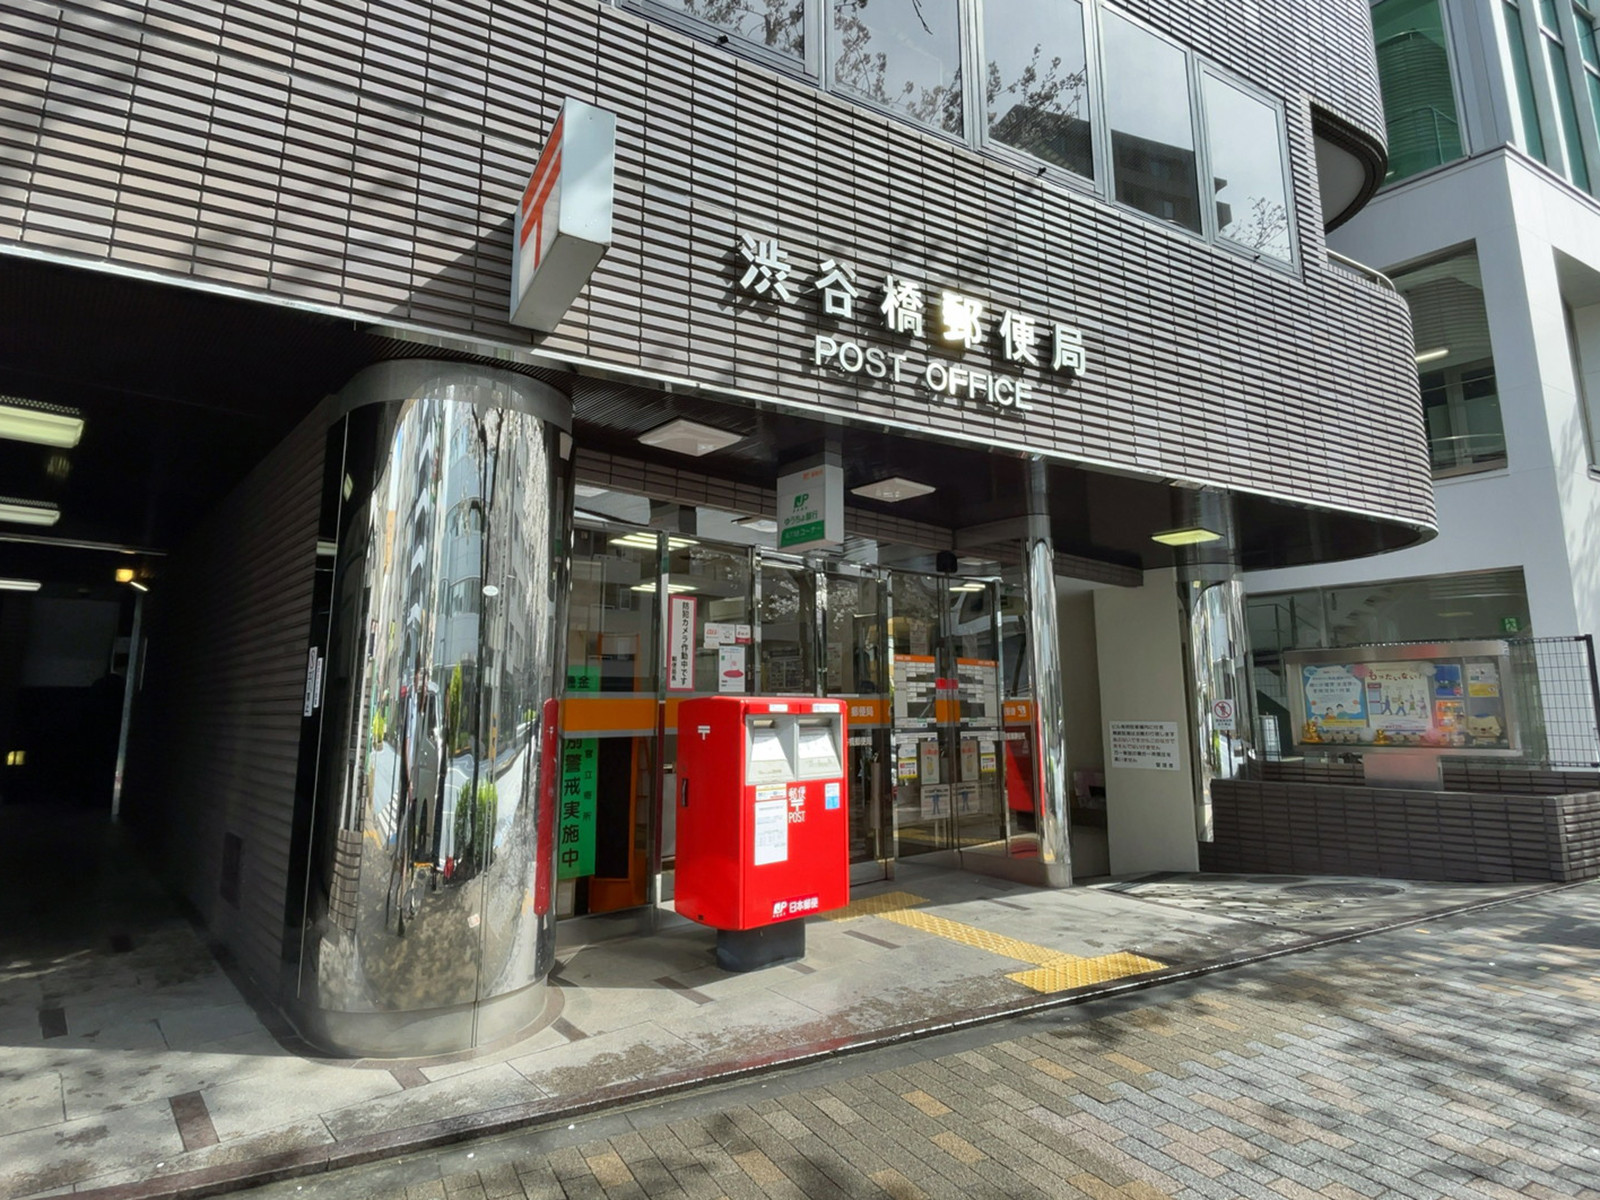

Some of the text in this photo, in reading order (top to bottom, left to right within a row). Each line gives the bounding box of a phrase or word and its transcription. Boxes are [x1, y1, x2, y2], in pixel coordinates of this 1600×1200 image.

[740, 233, 1085, 377] 渋谷橋郵便局
[813, 334, 1033, 411] POST OFFICE
[788, 786, 806, 801] 郵便
[788, 811, 806, 823] POST
[788, 896, 819, 914] 日本郵便
